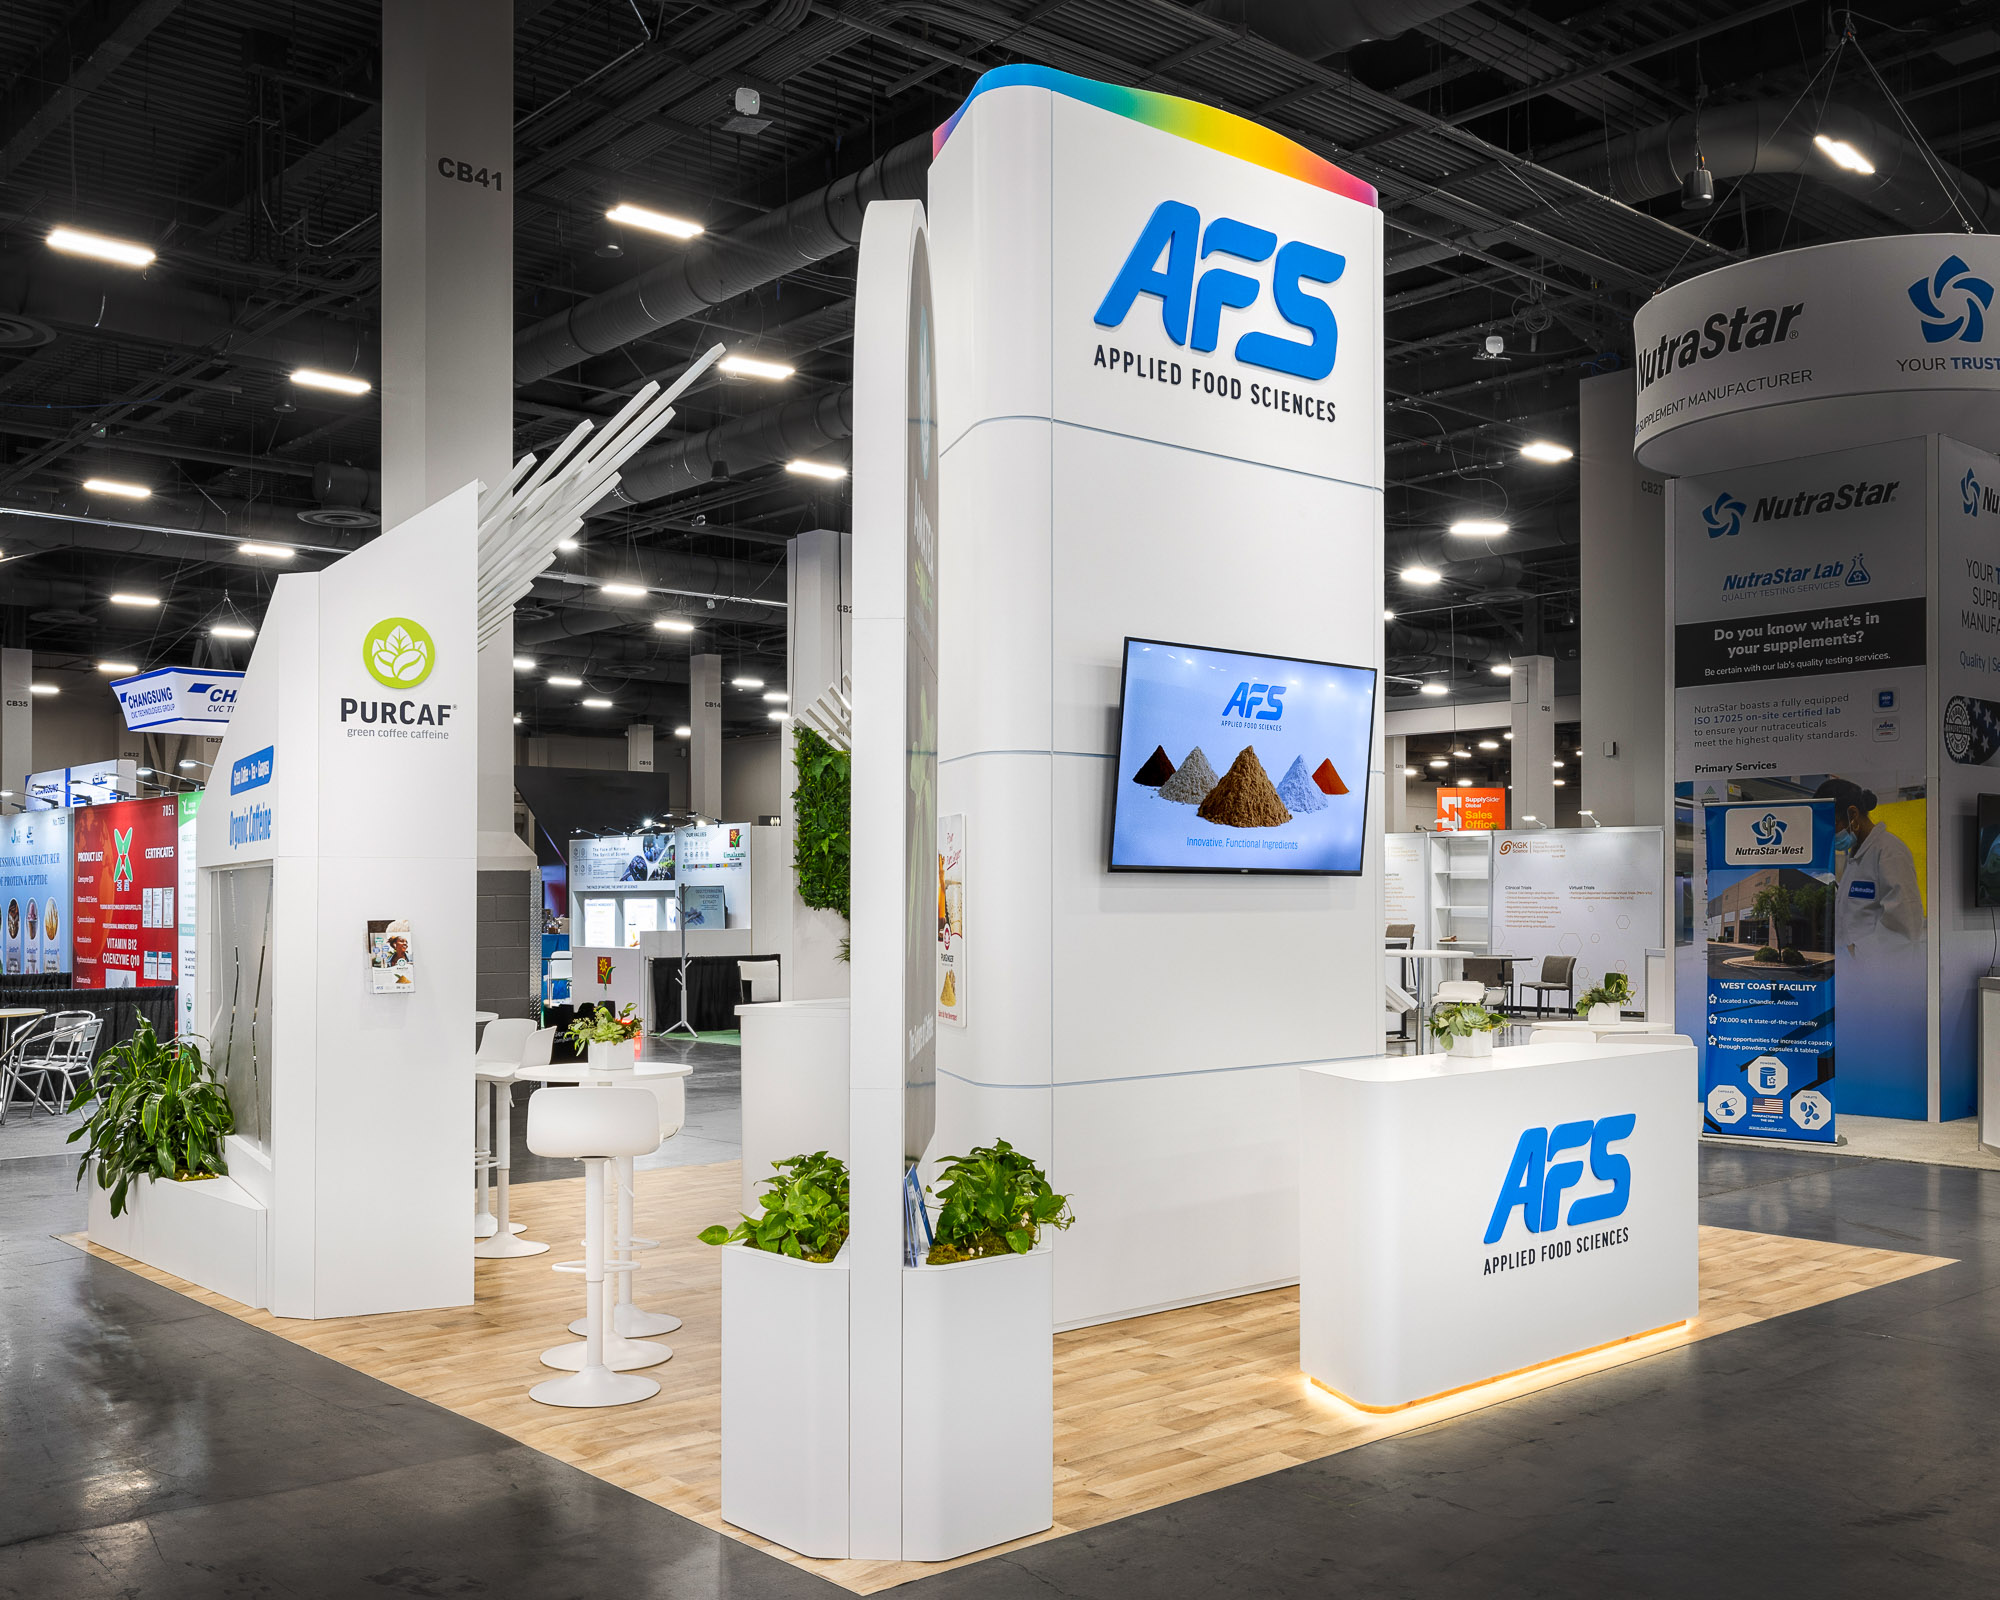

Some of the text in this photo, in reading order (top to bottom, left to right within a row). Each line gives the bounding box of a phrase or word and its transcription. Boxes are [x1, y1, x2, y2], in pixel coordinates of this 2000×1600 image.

[438, 158, 502, 192] CB41
[1093, 200, 1346, 381] AFS
[1896, 358, 1946, 372] YOUR
[1094, 344, 1336, 423] APPLIED FOOD SCIENCES
[1688, 369, 1812, 408] MANUFACTURER
[1642, 480, 1664, 496] CB27
[1723, 561, 1844, 591] NutraStar Lab
[1966, 558, 1993, 582] YOUR
[1722, 581, 1840, 602] QUALITY TESTING SERVICES
[1714, 629, 1734, 641] Do
[1738, 627, 1763, 641] you
[1767, 622, 1807, 636] know
[1866, 612, 1880, 624] in
[1728, 630, 1864, 658] your supplements?
[1704, 652, 1890, 676] Be certain with our lab's quality testing services.
[1960, 650, 1986, 672] Quality
[128, 687, 172, 709] CHANGSUNG
[210, 689, 237, 703] CH
[1222, 682, 1287, 721] AFS
[1694, 704, 1738, 714] NutraStar
[1740, 702, 1770, 710] boasts
[1781, 698, 1801, 707] fully
[1804, 694, 1848, 704] equipped
[138, 706, 162, 718] TECHNOLOGIES
[162, 704, 175, 712] GROUP
[1694, 706, 1840, 725] ISO 17025 on-site certified lab
[347, 728, 449, 740] green coffee caffeine
[1259, 723, 1282, 732] SCIENCES
[1694, 720, 1826, 736] to ensure your nutraceuticals
[1694, 738, 1716, 748] meet
[1718, 738, 1733, 746] the
[1736, 735, 1770, 746] highest
[1772, 733, 1804, 744] quality
[1807, 729, 1858, 740] standards.
[1694, 761, 1777, 774] Primary Services
[162, 804, 174, 816] 7051
[1466, 810, 1492, 819] Sales
[230, 802, 271, 850] Organic Caffeine
[145, 846, 174, 859] CERTIFICATES
[1186, 837, 1298, 850] Innovative, Functional Ingredients
[1736, 846, 1804, 856] NutraStar-West
[22, 853, 60, 866] MANUFACTURER
[78, 851, 104, 862] PRODUCT LIST
[4, 876, 24, 886] PROTEIN
[28, 874, 48, 885] PEPTIDE
[107, 938, 137, 950] VITAMIN B12
[102, 953, 130, 966] COENZYME
[130, 955, 140, 968] Q10
[1484, 1113, 1636, 1244] AFS
[1484, 1227, 1629, 1276] APPLIED FOOD SCIENCES
